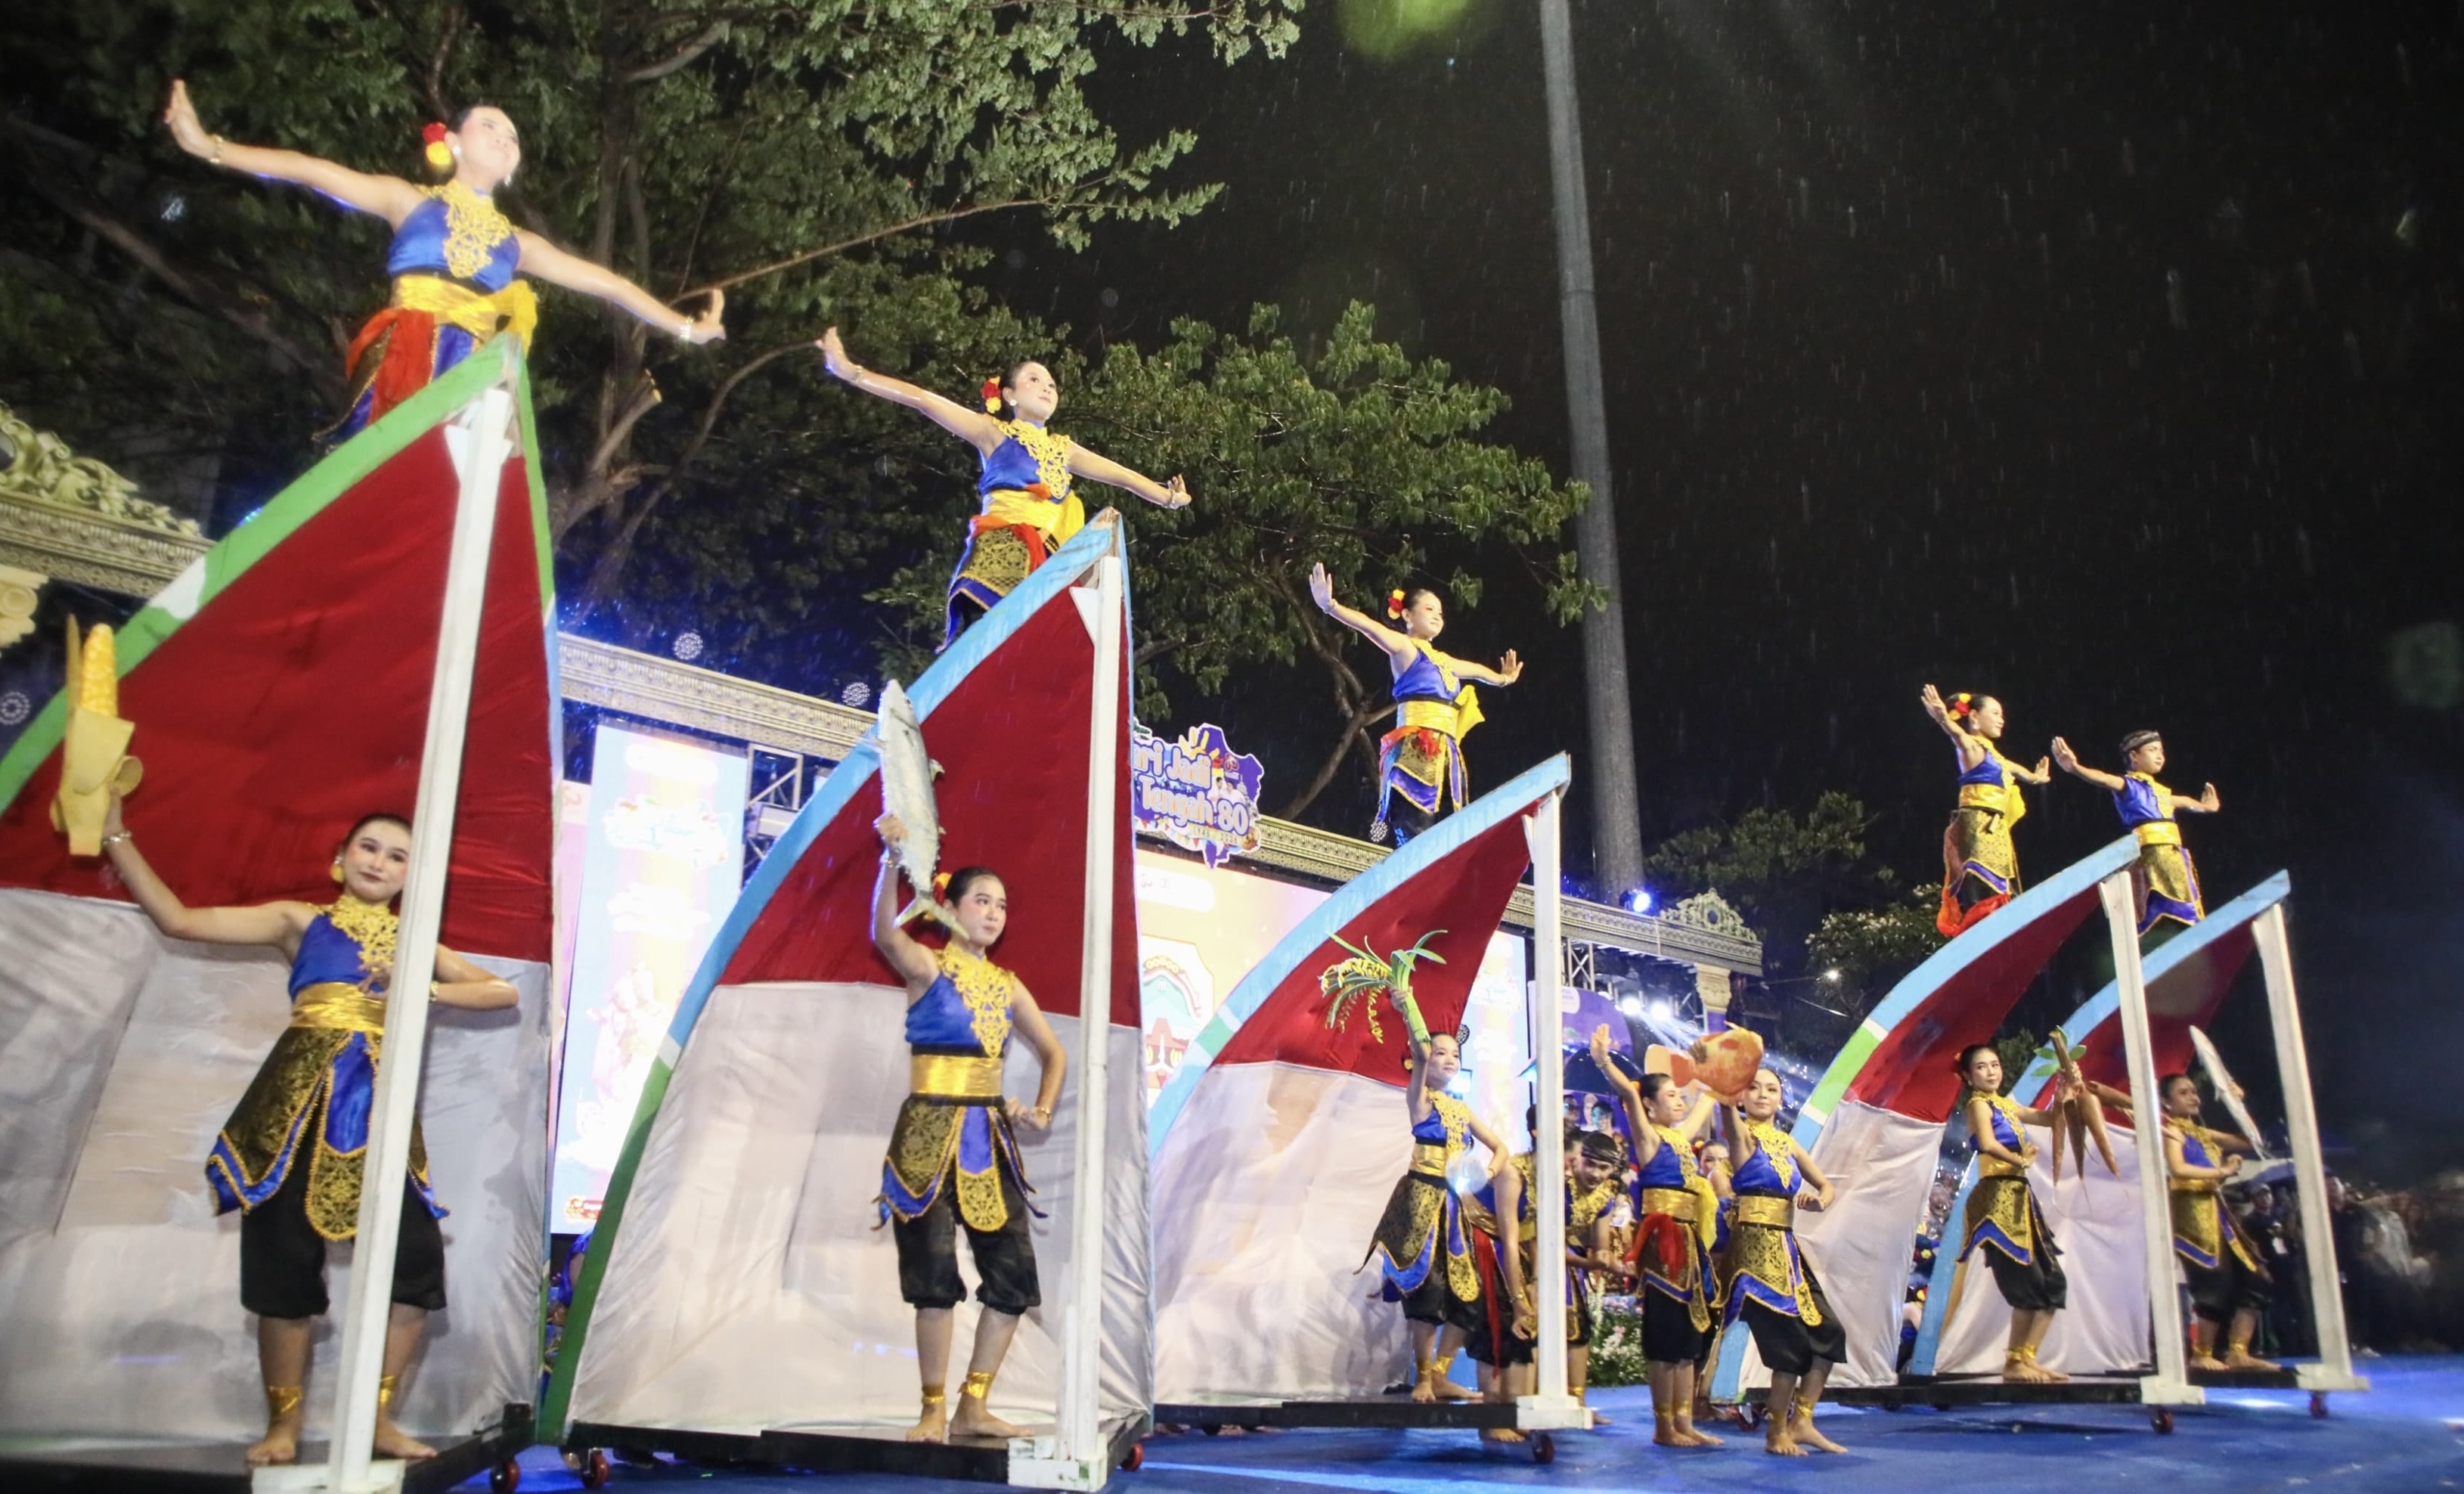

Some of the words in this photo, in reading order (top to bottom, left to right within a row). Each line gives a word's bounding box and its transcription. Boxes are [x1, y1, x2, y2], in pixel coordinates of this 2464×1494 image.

[1166, 746, 1211, 789] Jadi
[1138, 775, 1213, 828] Tengah
[1217, 799, 1249, 836] 80
